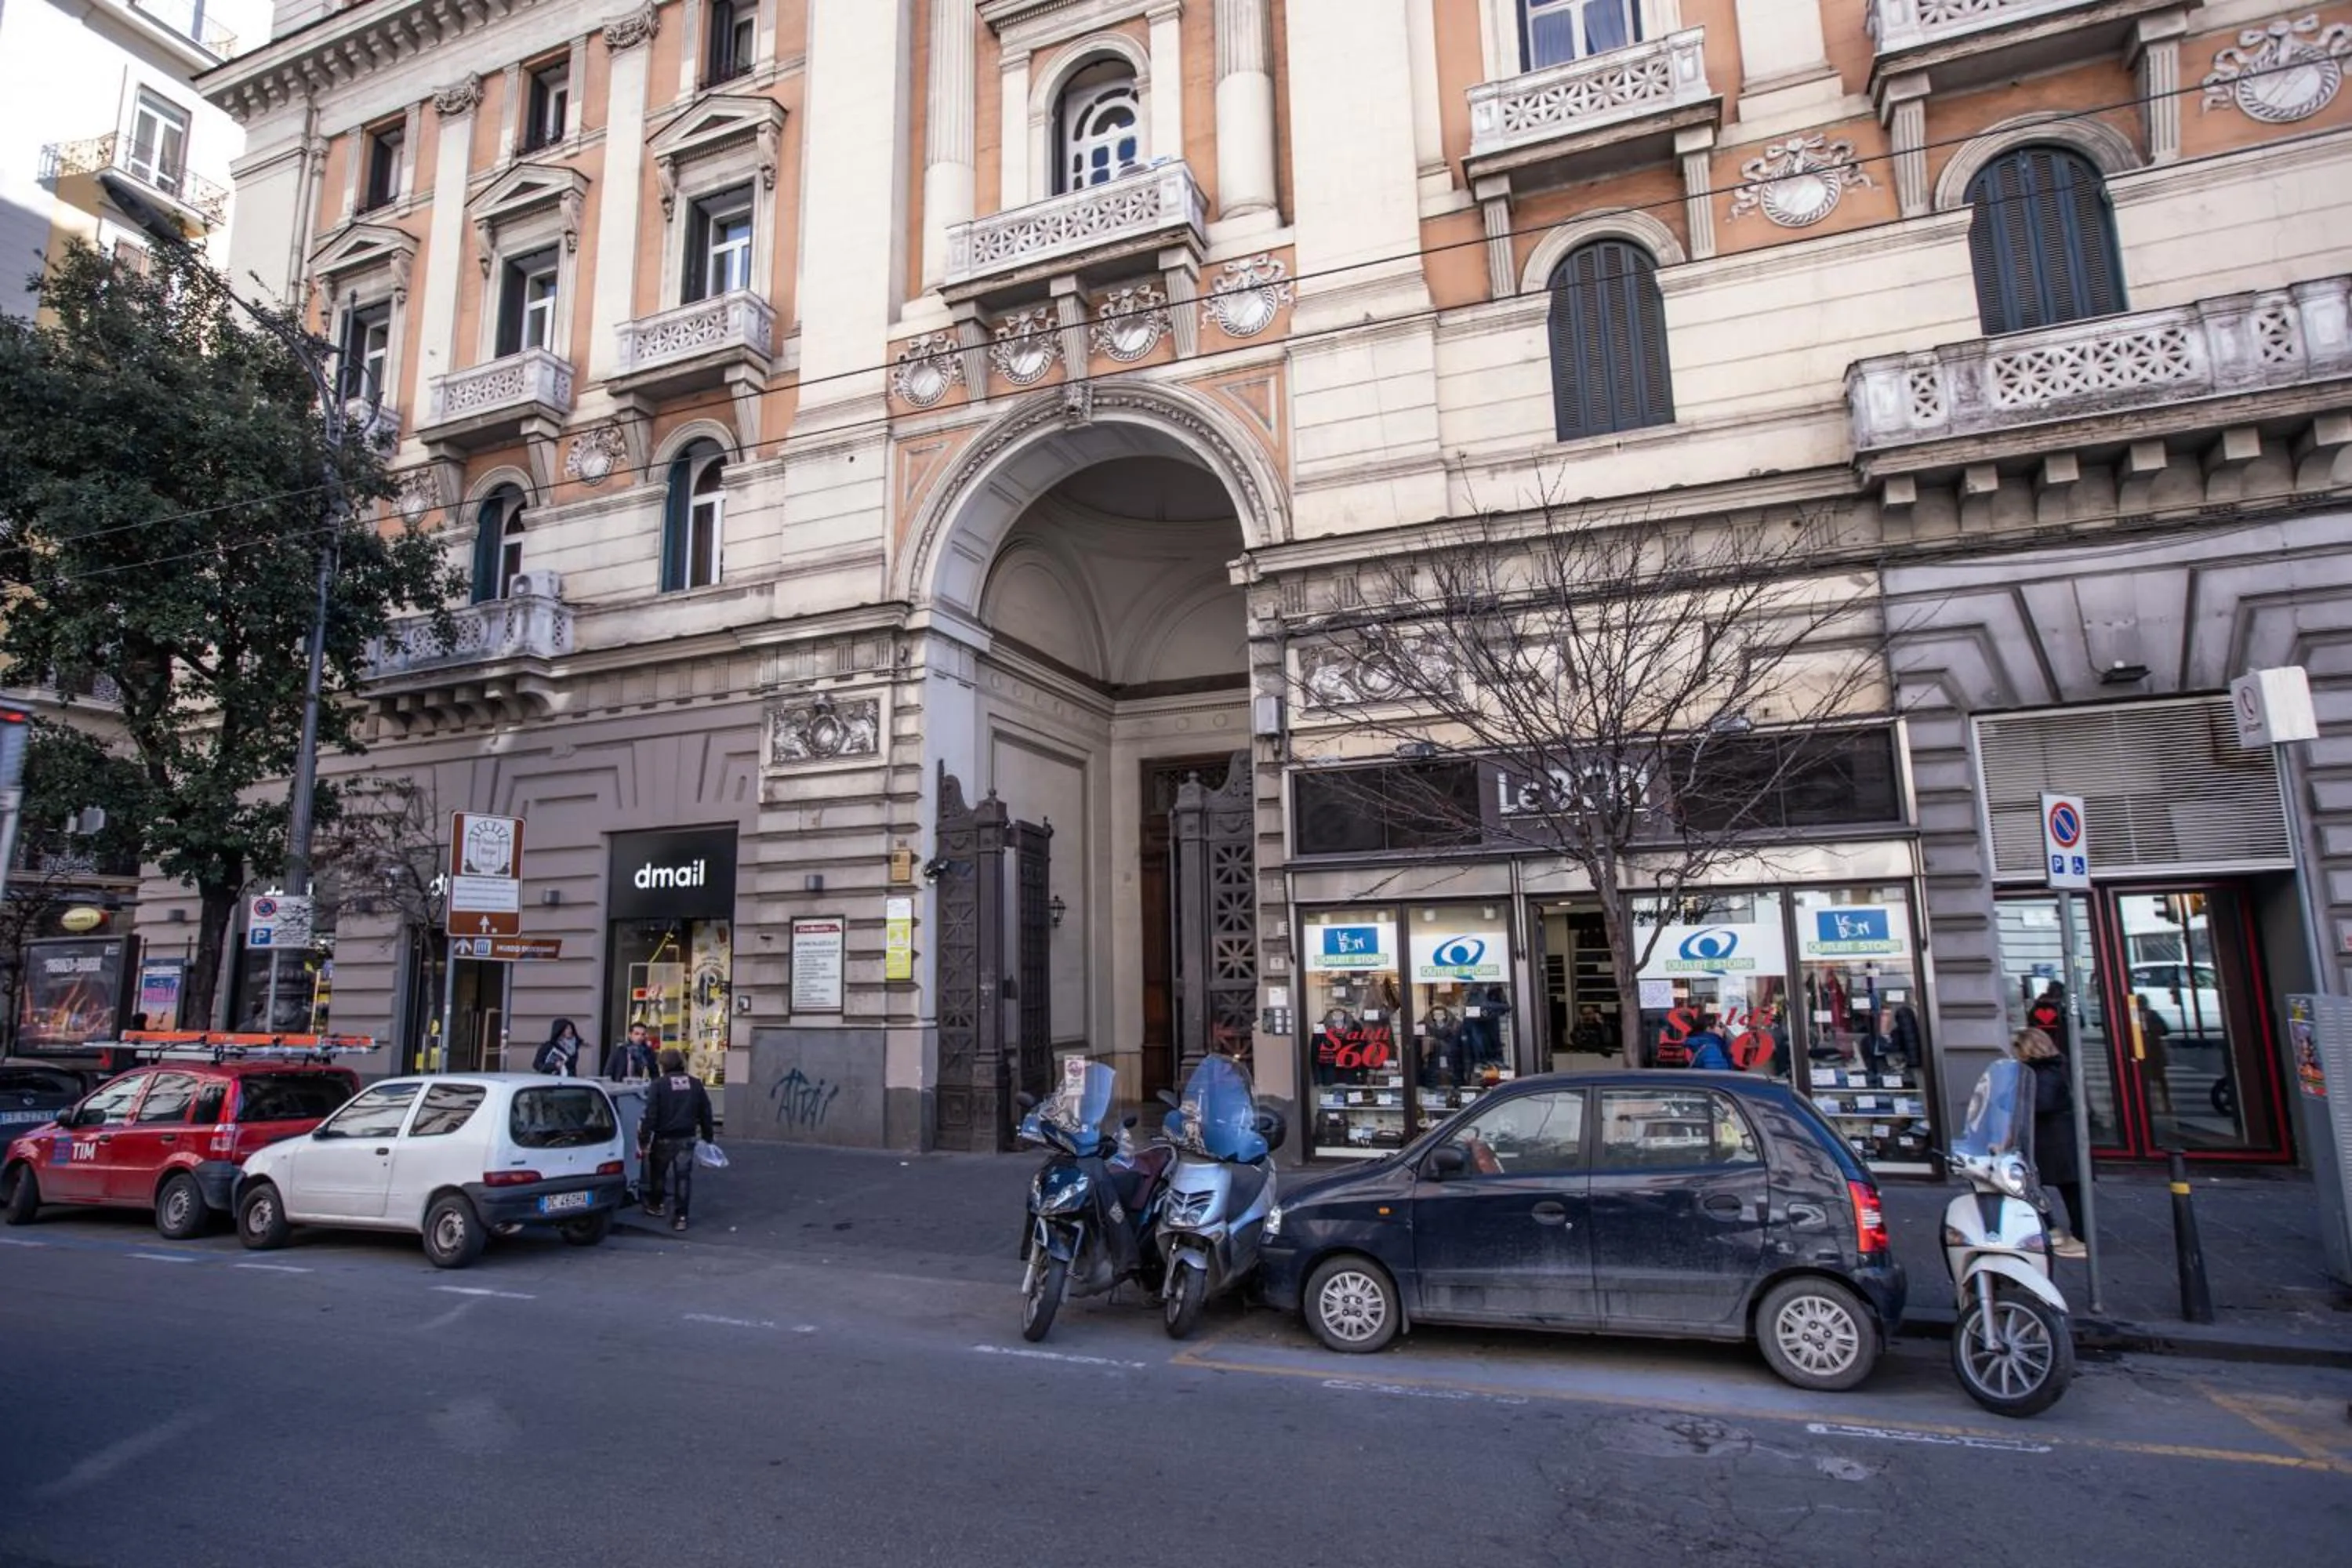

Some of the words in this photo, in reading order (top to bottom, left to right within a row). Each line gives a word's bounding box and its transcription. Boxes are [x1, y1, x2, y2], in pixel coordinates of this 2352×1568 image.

[634, 859, 705, 889] dmail
[254, 930, 268, 943] P
[1319, 1027, 1391, 1051] Saldi
[1336, 1041, 1389, 1068] 60
[73, 1142, 96, 1160] TIM
